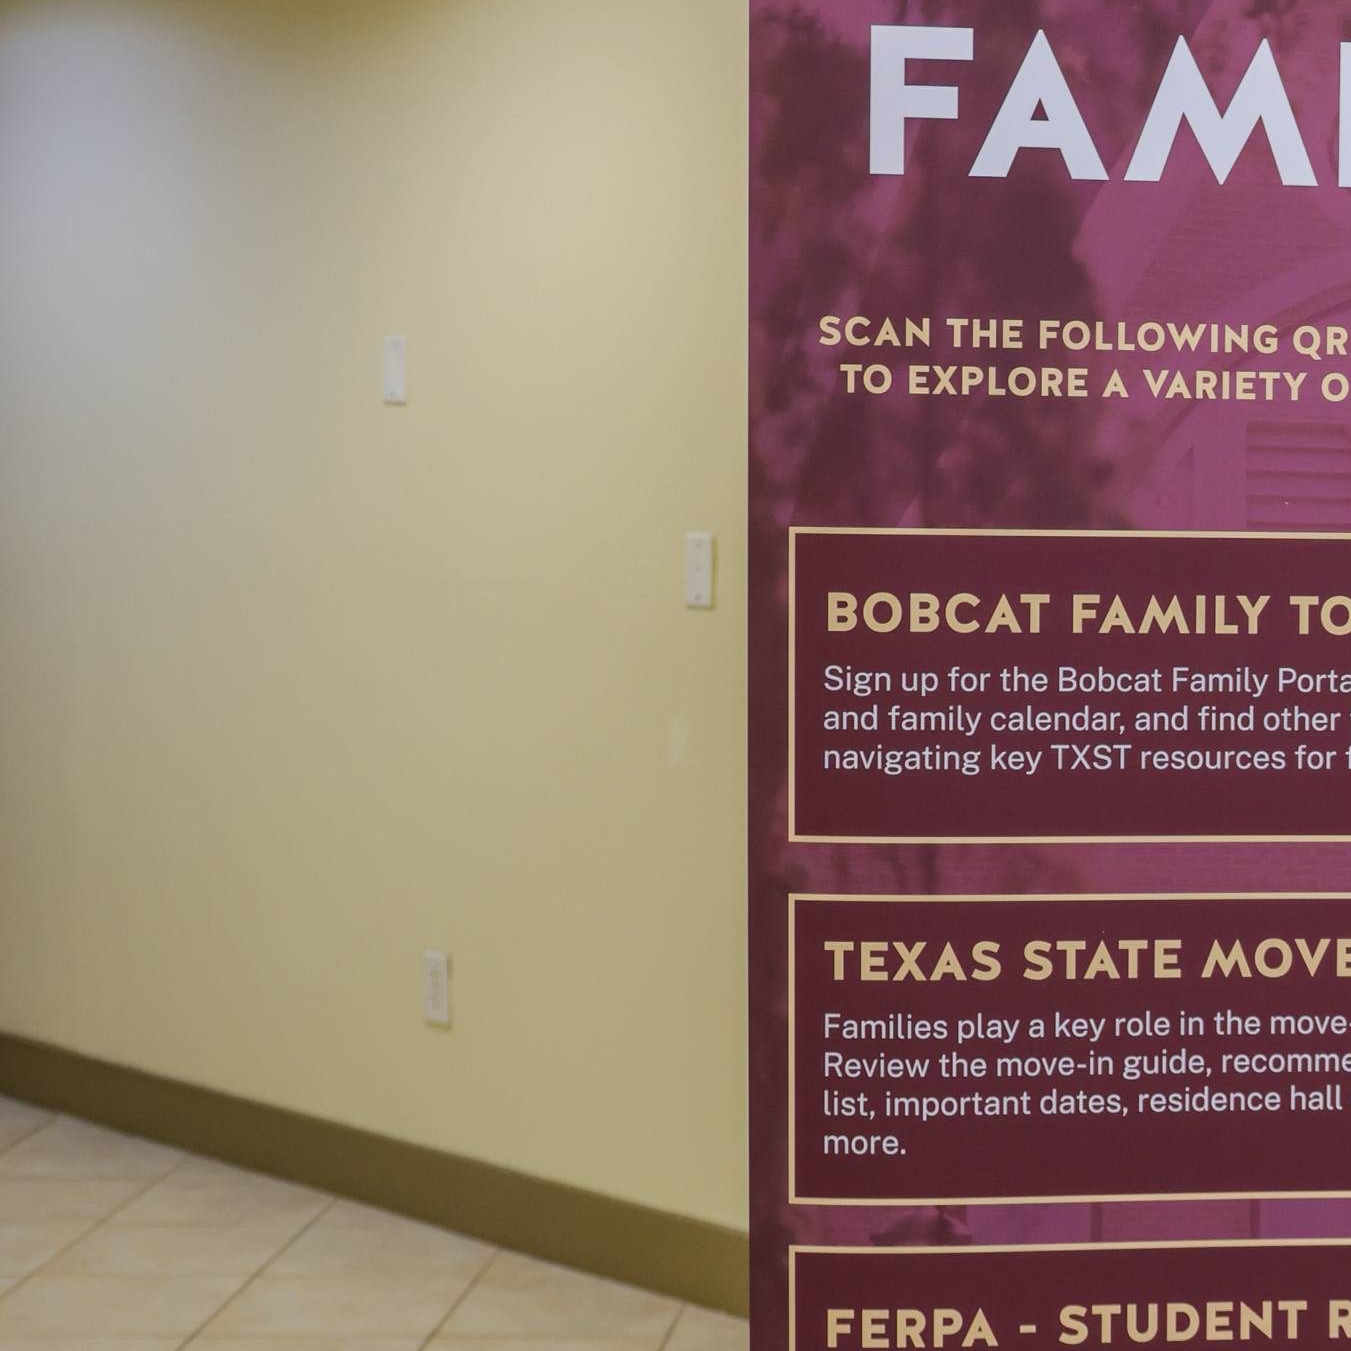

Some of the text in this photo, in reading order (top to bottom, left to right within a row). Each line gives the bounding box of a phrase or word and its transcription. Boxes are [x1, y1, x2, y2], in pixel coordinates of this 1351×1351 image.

[818, 315, 930, 348] SCAN
[946, 317, 1023, 350] THE
[1039, 319, 1279, 355] FOLLOWING
[1292, 324, 1349, 362] QR
[839, 363, 892, 395] TO
[908, 364, 1089, 398] EXPLORE
[1102, 367, 1129, 399] A
[1142, 368, 1308, 402] VARIETY
[827, 591, 1051, 634] BOBCAT
[1072, 592, 1271, 635] FAMILY
[823, 664, 891, 698] Sign
[901, 671, 939, 698] up
[947, 665, 991, 693] for
[999, 664, 1049, 694] the
[1058, 665, 1162, 694] Bobcat
[1172, 665, 1269, 698] Family
[823, 703, 878, 732] and
[887, 703, 982, 737] family
[990, 703, 1125, 736] calendar,
[1134, 704, 1188, 732] and
[1197, 704, 1254, 732] find
[1263, 704, 1342, 733] other
[824, 743, 982, 777] navigating
[990, 743, 1043, 776] key
[1050, 743, 1132, 771] TXST
[1141, 749, 1286, 771] resources
[1294, 743, 1337, 770] for
[823, 940, 1002, 982] TEXAS
[1023, 938, 1182, 981] STATE
[824, 1012, 948, 1040] Families
[957, 1012, 1020, 1045] play
[1028, 1017, 1045, 1039] a
[1055, 1010, 1106, 1043] key
[1115, 1009, 1171, 1038] role
[1180, 1009, 1204, 1037] in
[1213, 1009, 1261, 1037] the
[824, 1051, 930, 1079] Review
[938, 1050, 987, 1079] the
[996, 1049, 1114, 1078] move-in
[1122, 1046, 1212, 1081] guide,
[823, 1089, 876, 1122] list,
[885, 1089, 1031, 1122] important
[1039, 1087, 1129, 1118] dates,
[1138, 1085, 1281, 1113] residence
[1290, 1083, 1343, 1111] hall
[823, 1134, 906, 1156] more.
[827, 1307, 999, 1350] FERPA
[1058, 1299, 1308, 1346] STUDENT
